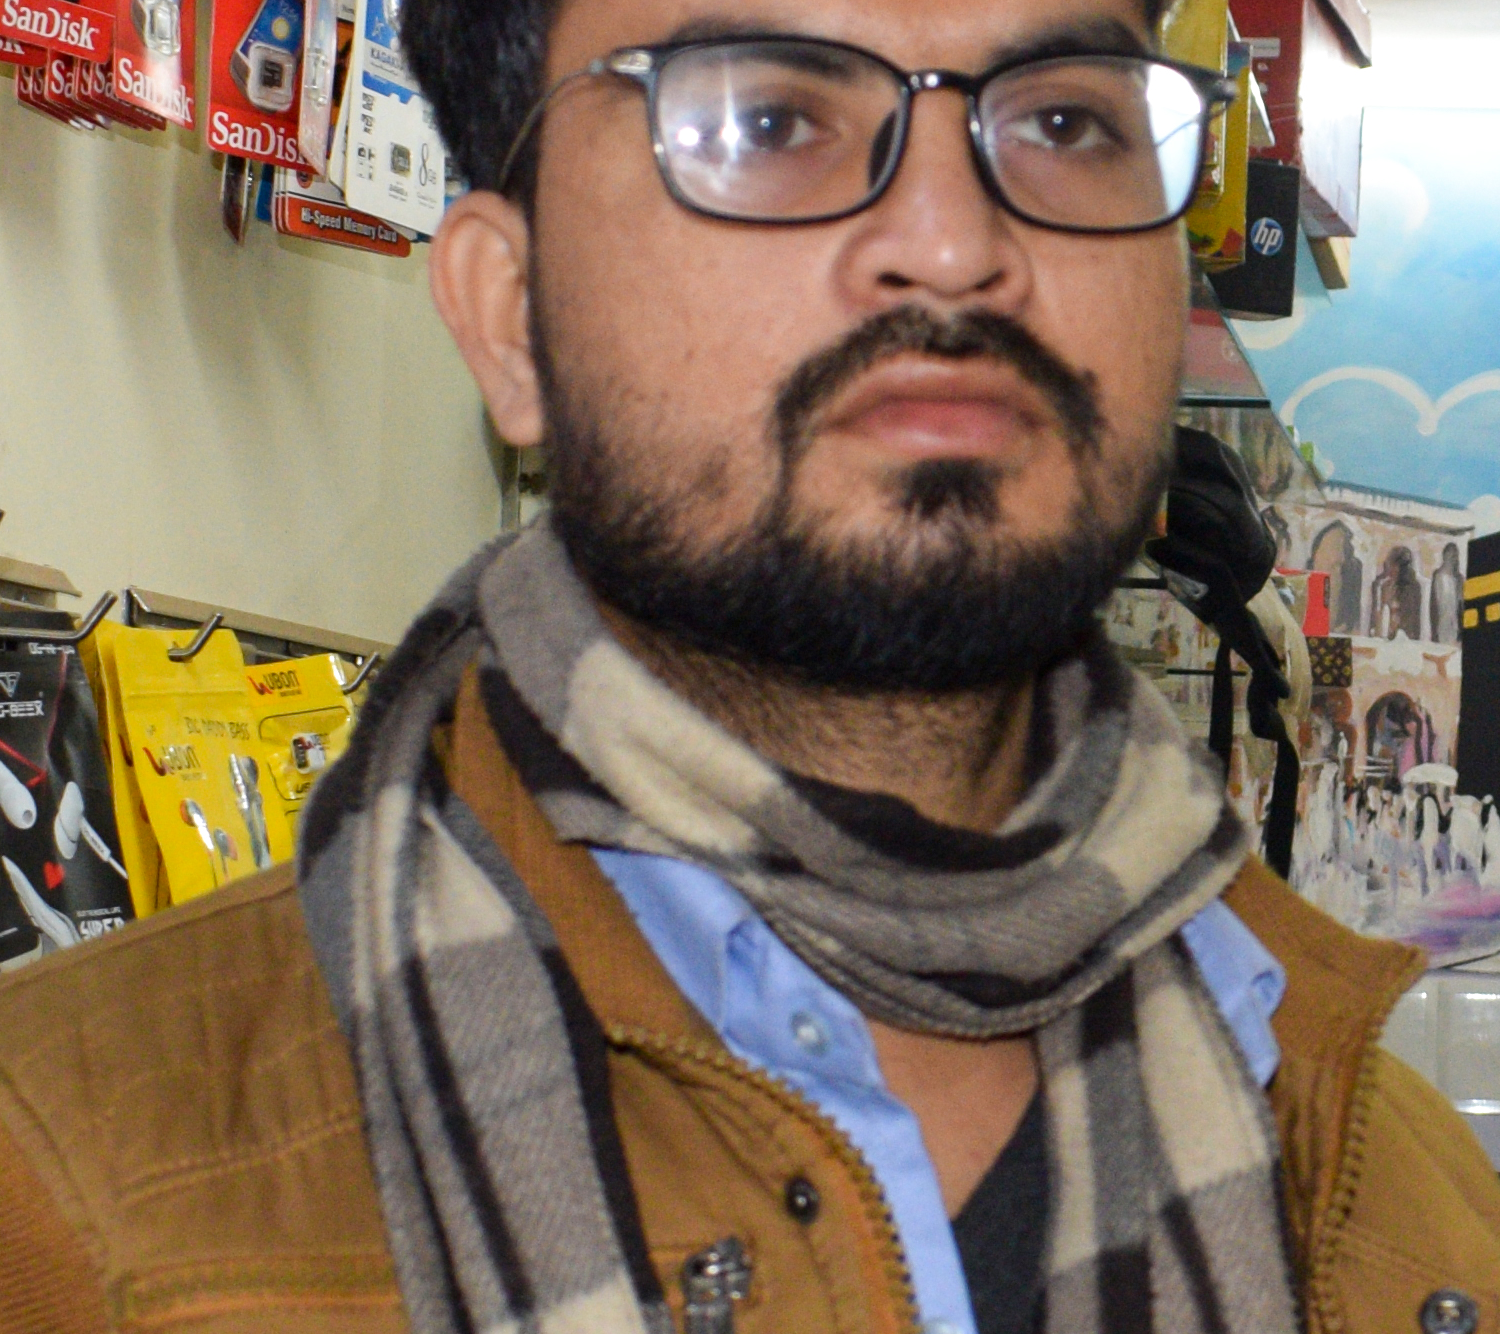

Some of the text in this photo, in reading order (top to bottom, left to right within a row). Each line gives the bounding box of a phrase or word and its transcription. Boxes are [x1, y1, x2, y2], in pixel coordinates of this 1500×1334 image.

[212, 109, 306, 166] SanDis
[301, 206, 398, 243] Hi-Speed Memory Card
[1254, 218, 1282, 256] hp
[263, 669, 301, 691] UBON
